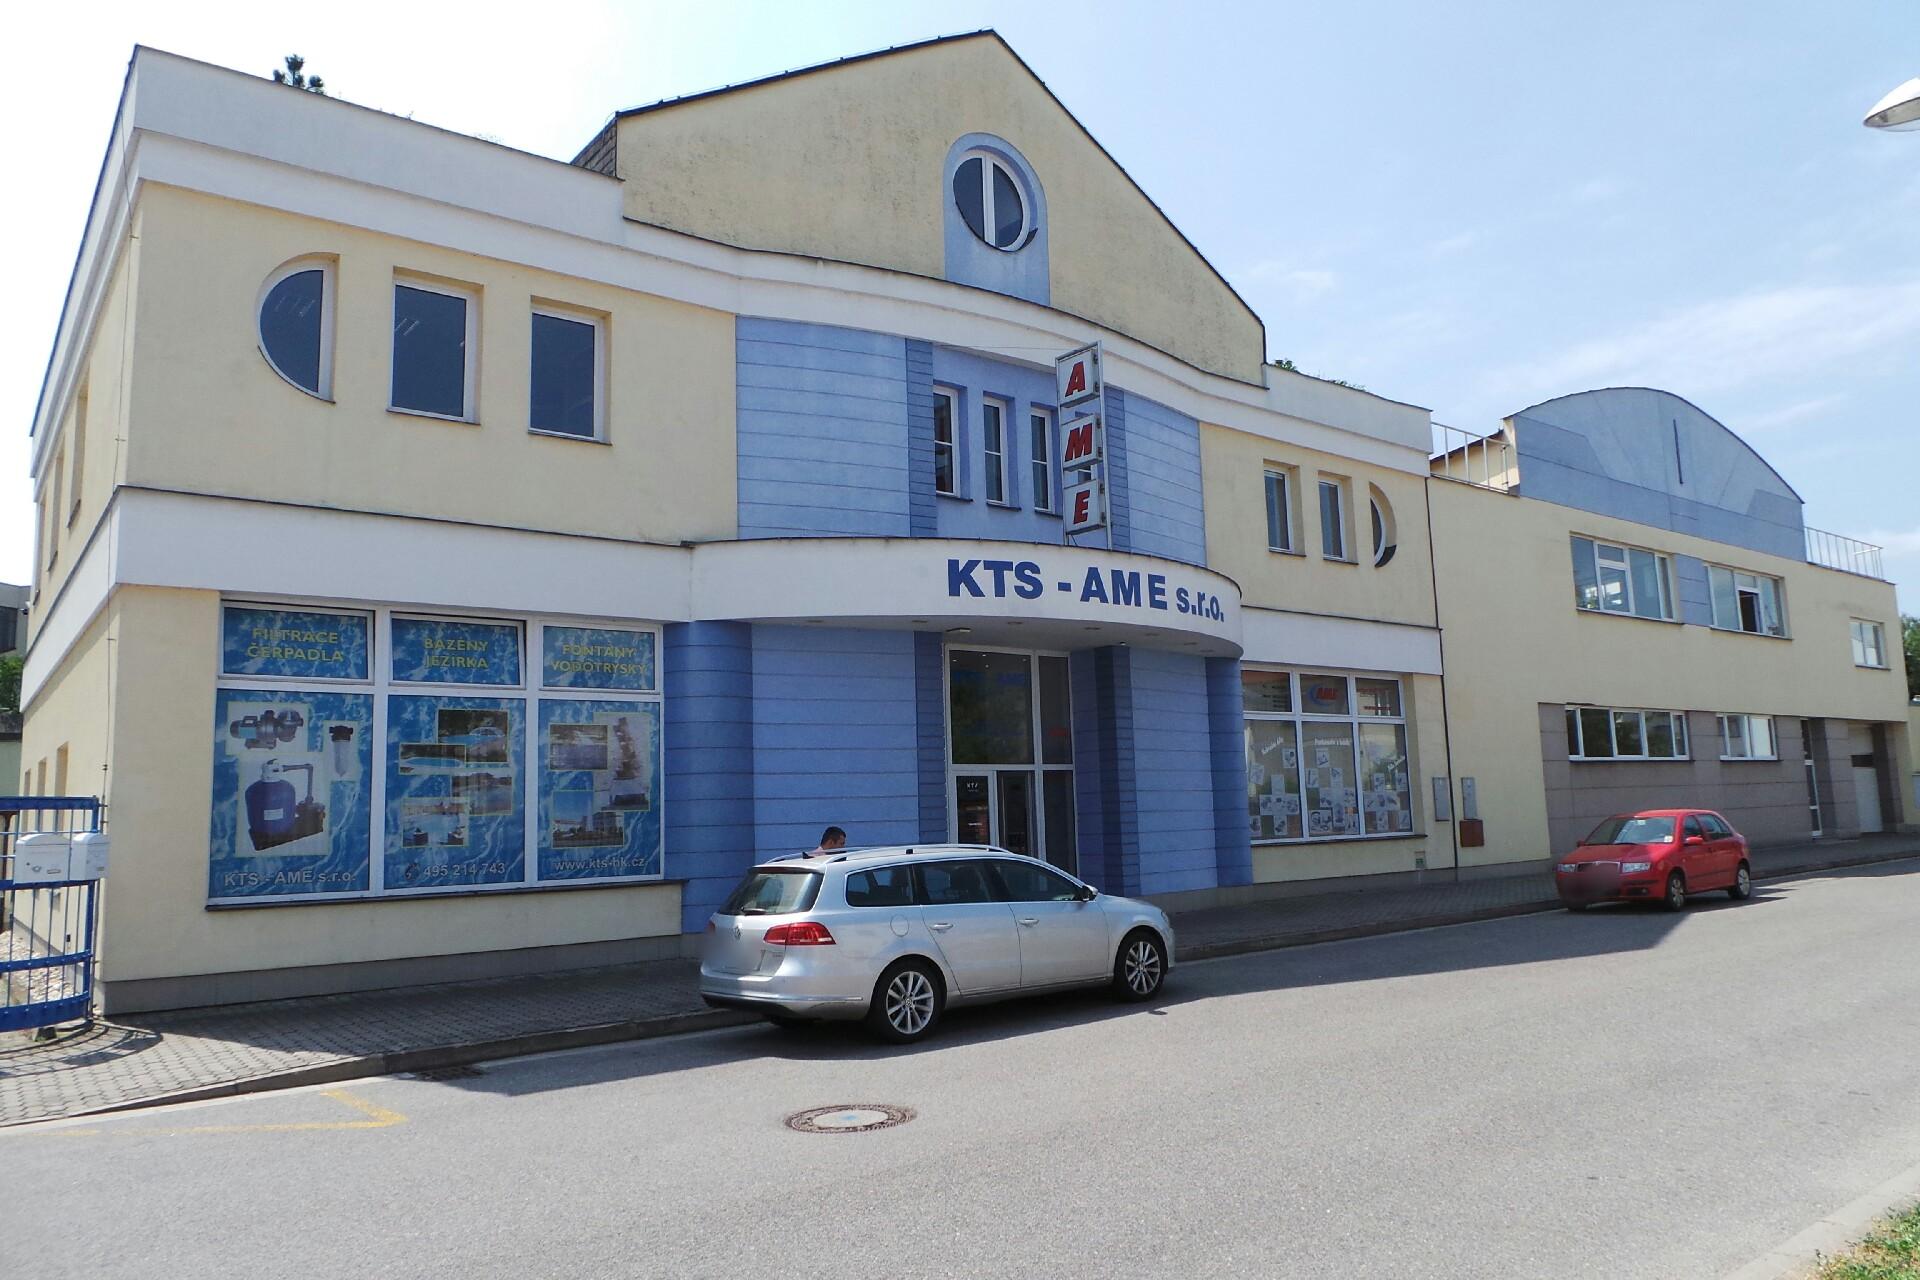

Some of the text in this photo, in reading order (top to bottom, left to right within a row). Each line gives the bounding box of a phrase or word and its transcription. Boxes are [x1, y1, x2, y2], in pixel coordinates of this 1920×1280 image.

[947, 558, 1043, 599] KTS
[1079, 566, 1168, 610] AME
[1176, 587, 1225, 623] s.r.o.
[252, 627, 338, 645] FILTRACE
[247, 643, 343, 662] ČERPADLA
[551, 660, 646, 674] VODOTRYSKY
[423, 862, 506, 876] 495 214 743
[553, 856, 645, 870] www.kts-hk.cz
[224, 872, 258, 886] KTS
[274, 870, 313, 884] AME
[318, 872, 356, 882] s.r.o.
